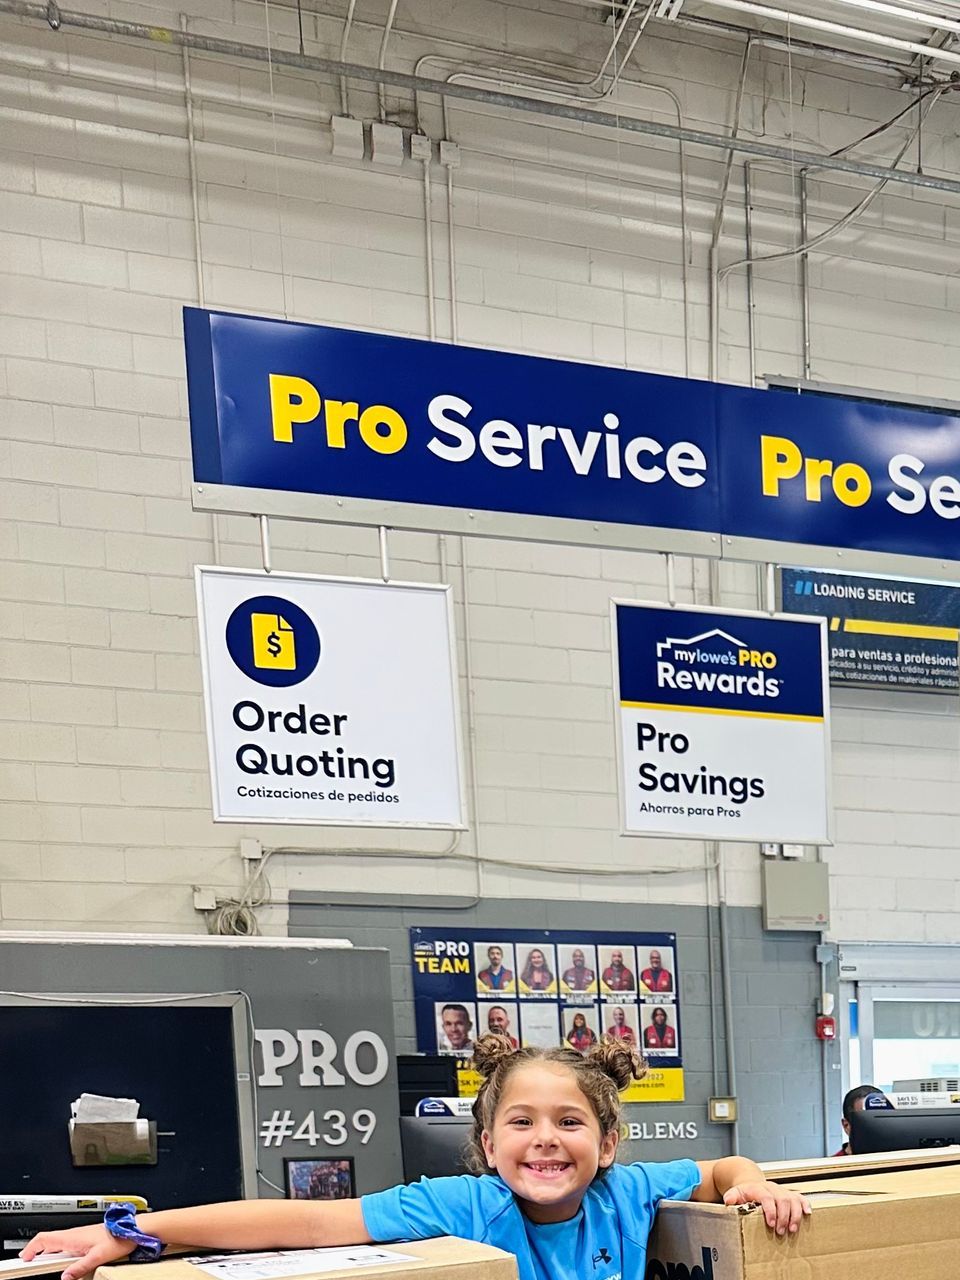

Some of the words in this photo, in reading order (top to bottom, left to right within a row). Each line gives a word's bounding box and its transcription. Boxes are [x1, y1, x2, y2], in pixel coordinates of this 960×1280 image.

[268, 373, 408, 455] Pro
[426, 394, 708, 488] Service
[760, 435, 872, 508] Pro
[814, 583, 865, 600] LOADING
[867, 587, 916, 605] SERVICE
[738, 649, 777, 669] PRO
[831, 647, 856, 659] para
[858, 649, 893, 662] ventas
[895, 653, 902, 662] a
[657, 661, 780, 698] Rewards
[233, 700, 347, 736] Order
[636, 722, 689, 754] Pro
[236, 743, 395, 788] Quoting
[237, 786, 325, 801] Cotizaciones
[328, 790, 345, 801] de
[348, 791, 399, 803] pedidos
[639, 762, 765, 804] Savings
[640, 803, 684, 815] Ahorros
[687, 806, 714, 817] para
[717, 806, 741, 817] Pros
[415, 957, 470, 974] TEAM
[434, 941, 470, 956] PRO
[254, 1029, 389, 1088] PRO
[259, 1109, 377, 1148] #439
